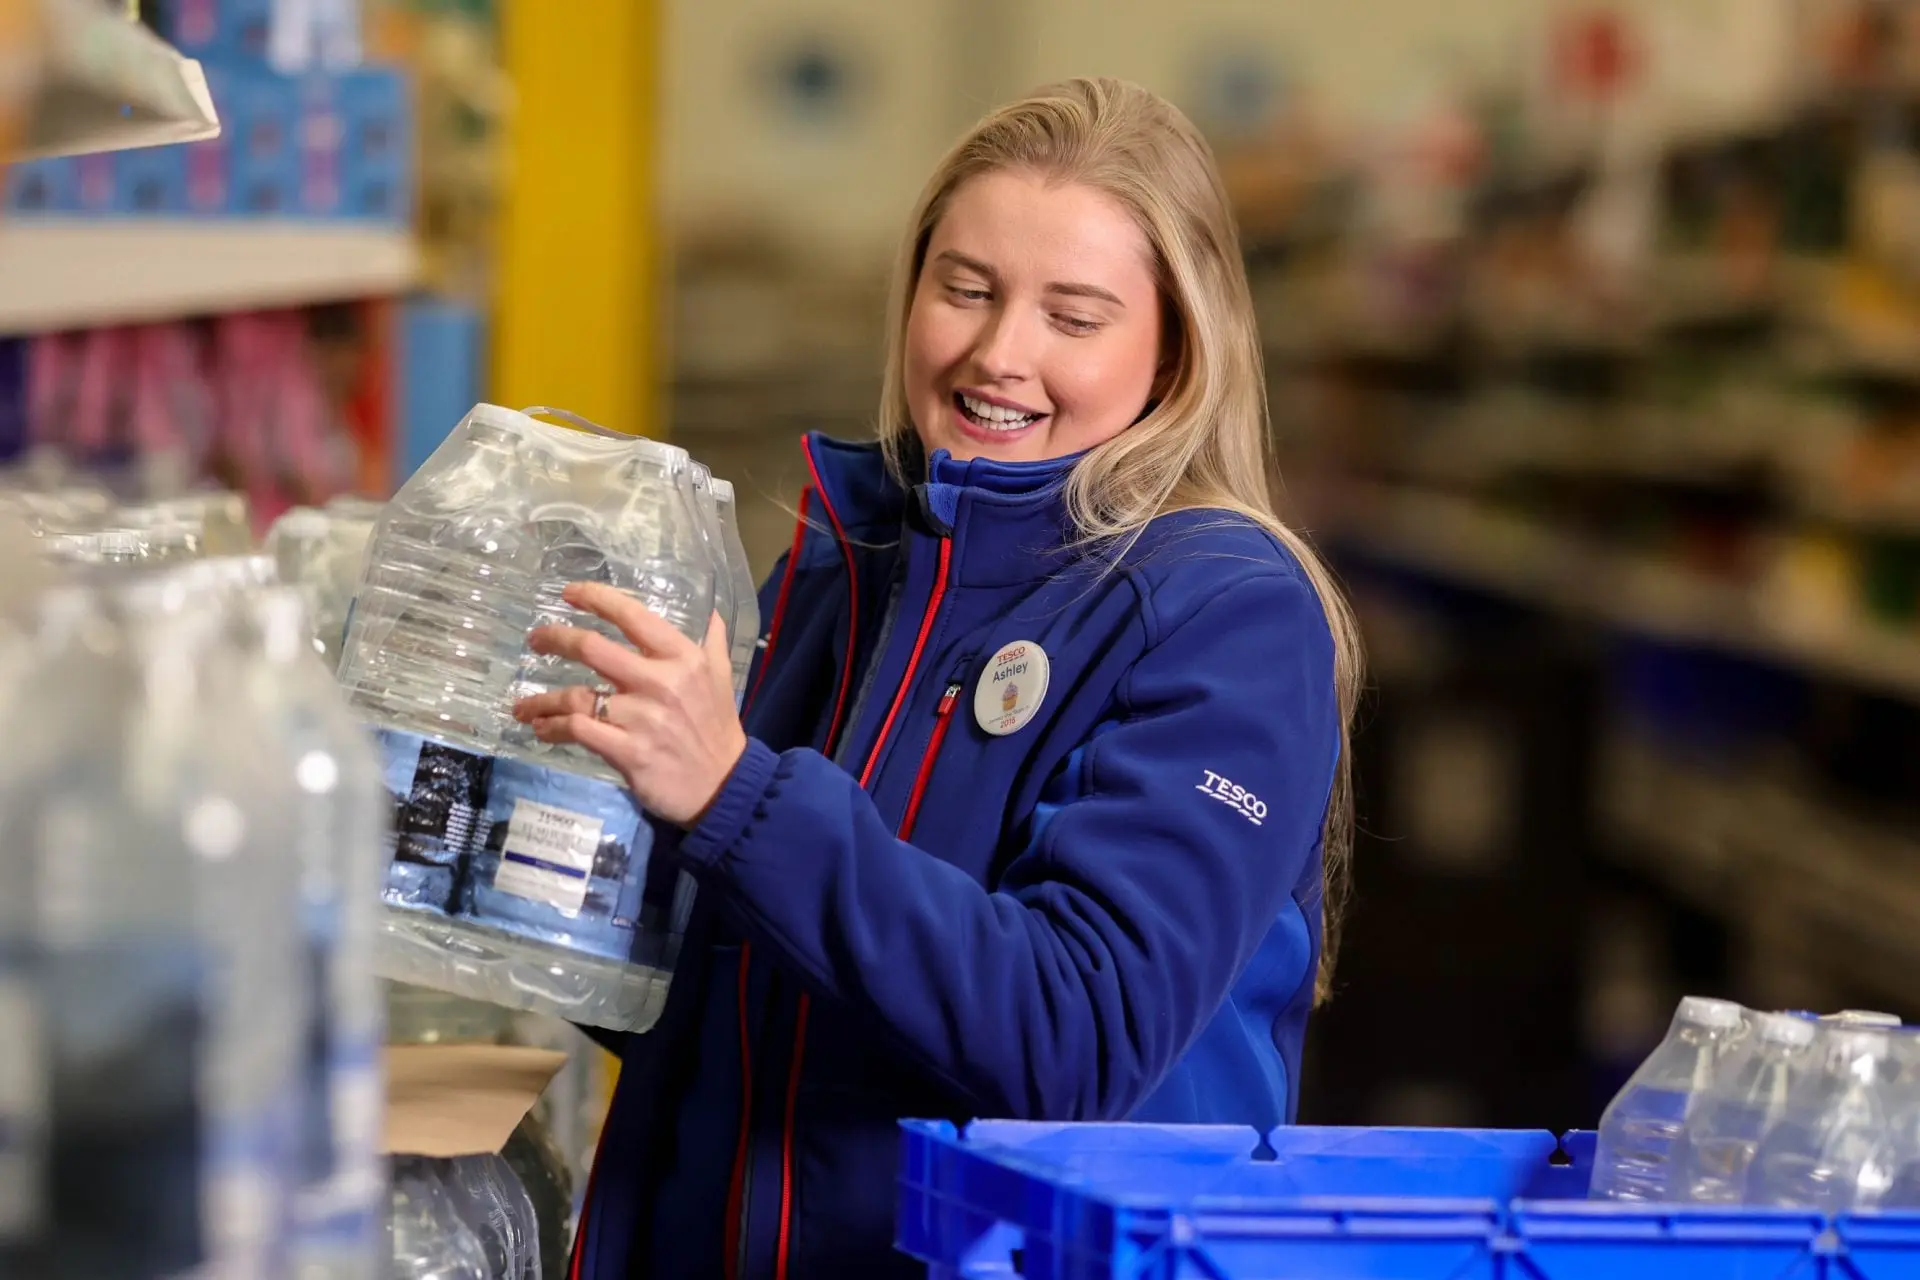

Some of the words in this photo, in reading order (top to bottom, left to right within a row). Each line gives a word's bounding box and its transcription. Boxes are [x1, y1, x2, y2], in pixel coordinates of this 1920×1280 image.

[997, 646, 1026, 663] TESCO
[992, 662, 1029, 684] Ashley
[1203, 769, 1268, 819] TESCO
